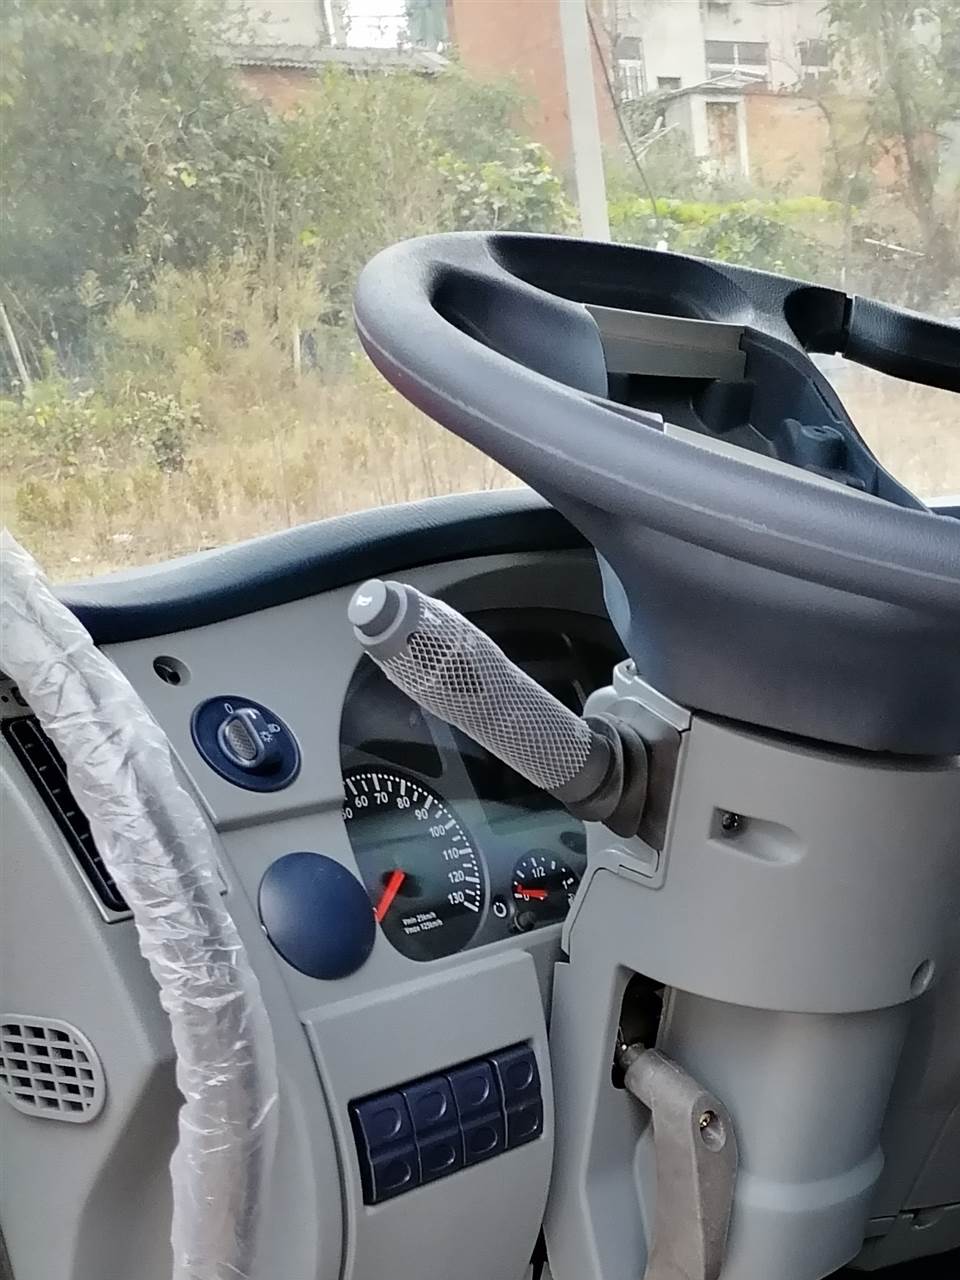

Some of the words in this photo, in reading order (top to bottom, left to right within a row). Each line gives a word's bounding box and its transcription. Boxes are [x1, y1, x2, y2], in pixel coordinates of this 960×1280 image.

[354, 795, 369, 808] 60
[373, 791, 389, 805] 70
[396, 796, 411, 809] 80
[414, 808, 429, 821] 90
[429, 824, 446, 838] 100
[443, 847, 460, 861] 110
[448, 870, 465, 884] 120
[531, 866, 546, 878] 1/2
[448, 891, 465, 905] 130
